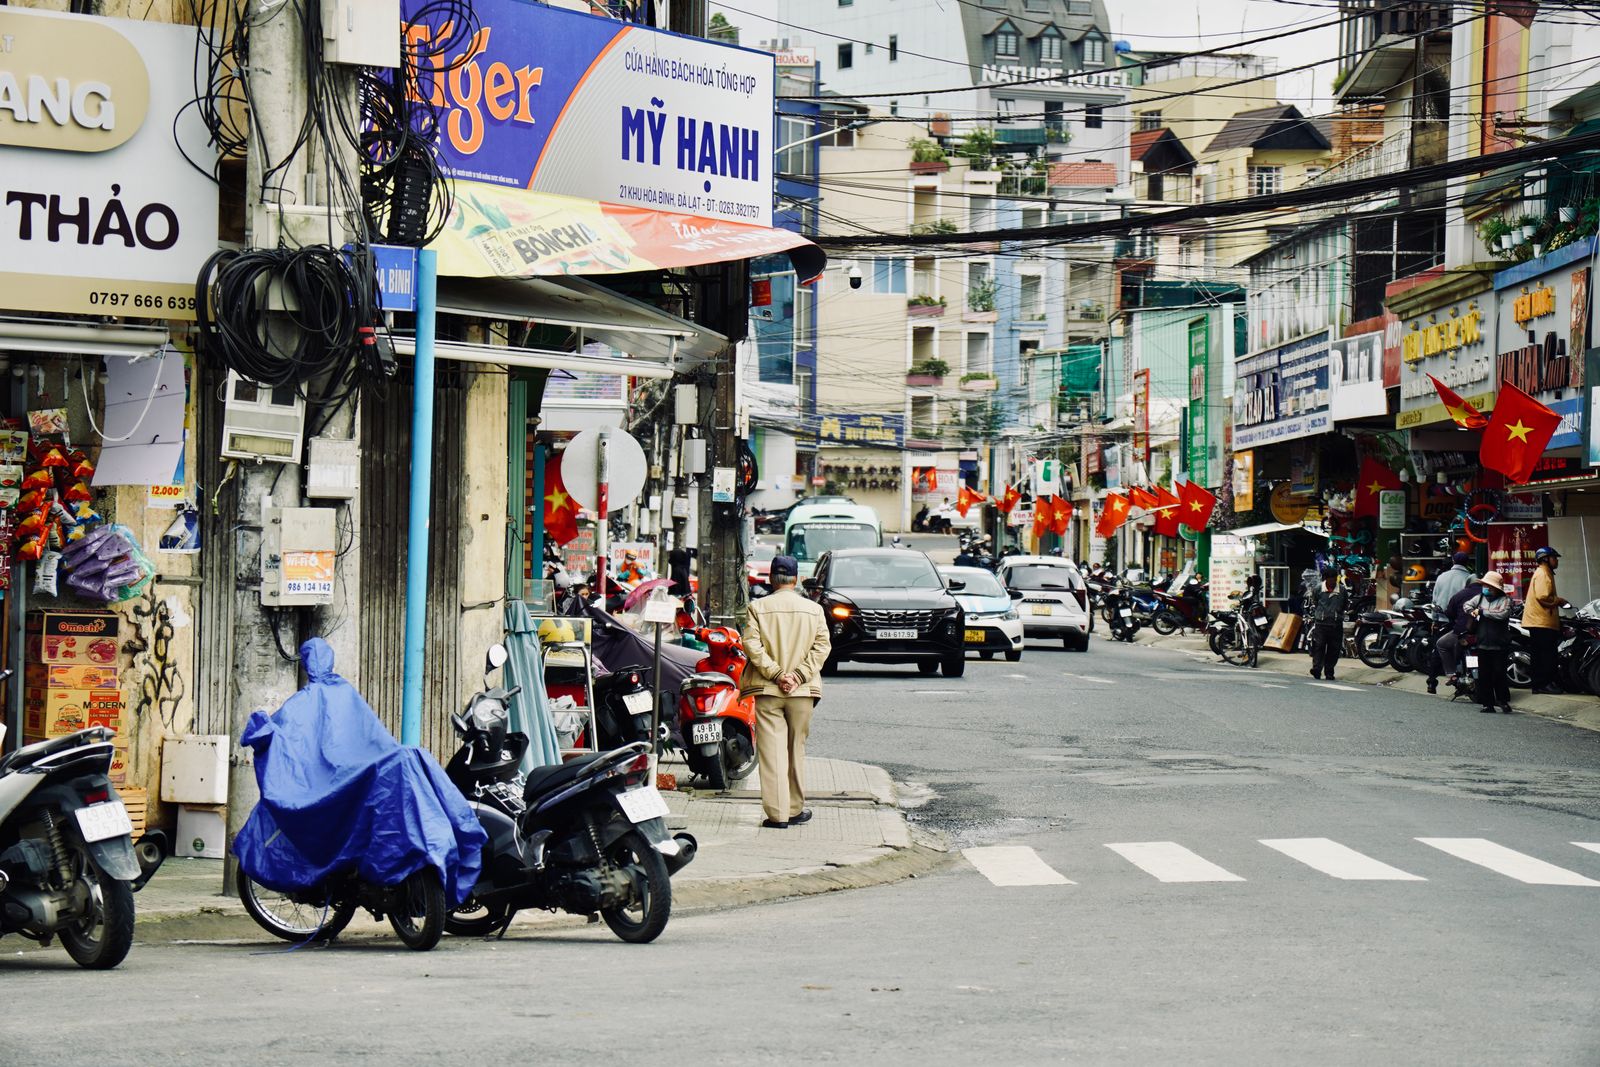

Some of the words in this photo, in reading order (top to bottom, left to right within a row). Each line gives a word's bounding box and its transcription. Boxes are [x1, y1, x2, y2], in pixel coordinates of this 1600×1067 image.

[400, 20, 544, 155] Tiger
[625, 47, 644, 73] CỬA
[645, 53, 670, 79] HÀNG
[671, 58, 694, 83] BÁCH
[696, 63, 714, 87] HÓA
[716, 63, 738, 92] TỔNG
[740, 75, 756, 99] HỢP
[982, 63, 1063, 87] NATURE
[621, 97, 667, 166] MỸ
[677, 115, 759, 193] HẠNH
[6, 183, 180, 250] THẢO
[619, 184, 628, 199] 21
[627, 186, 643, 201] KHU
[643, 187, 657, 203] HÒA
[677, 193, 687, 208] ĐÀ
[688, 196, 701, 213] LẠT
[719, 202, 760, 219] 0263.3821757
[388, 263, 411, 295] BÌNH
[90, 291, 129, 306] 0797
[134, 294, 163, 308] 666
[168, 296, 196, 310] 639
[288, 582, 301, 592] 986
[303, 582, 316, 592] 134
[318, 583, 331, 592] 142
[58, 620, 101, 633] Omachi
[83, 701, 126, 710] MODERN
